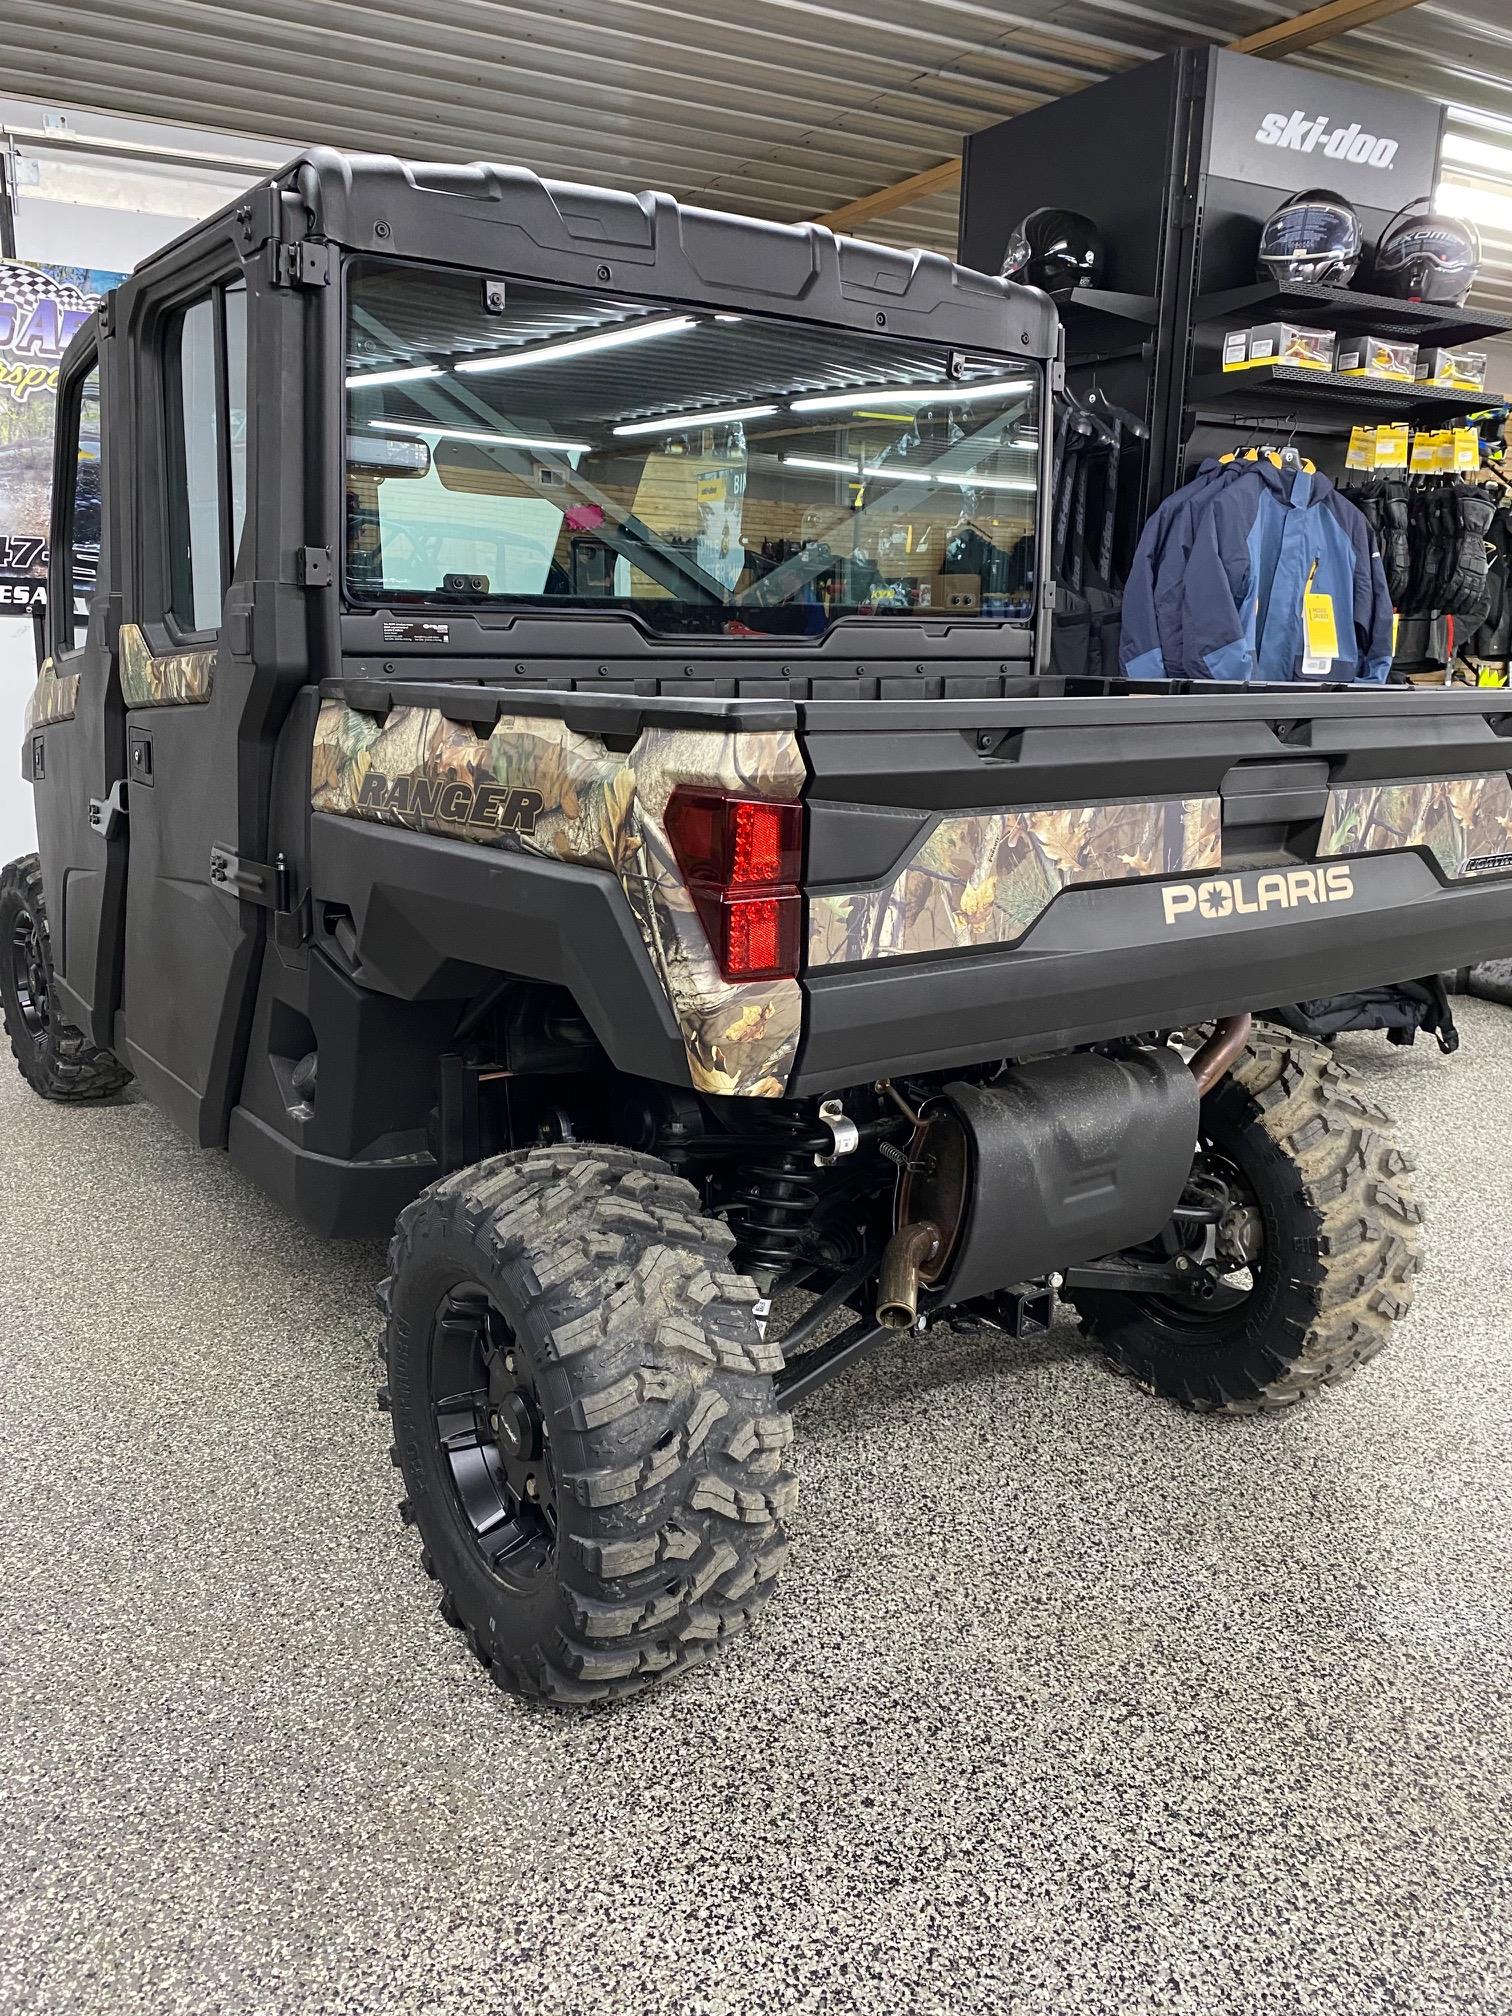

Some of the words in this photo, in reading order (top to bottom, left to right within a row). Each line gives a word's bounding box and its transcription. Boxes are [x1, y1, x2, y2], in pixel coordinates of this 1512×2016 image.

[1255, 110, 1399, 169] ski-doo
[357, 771, 544, 835] RANGER
[1161, 865, 1354, 925] POLARIS
